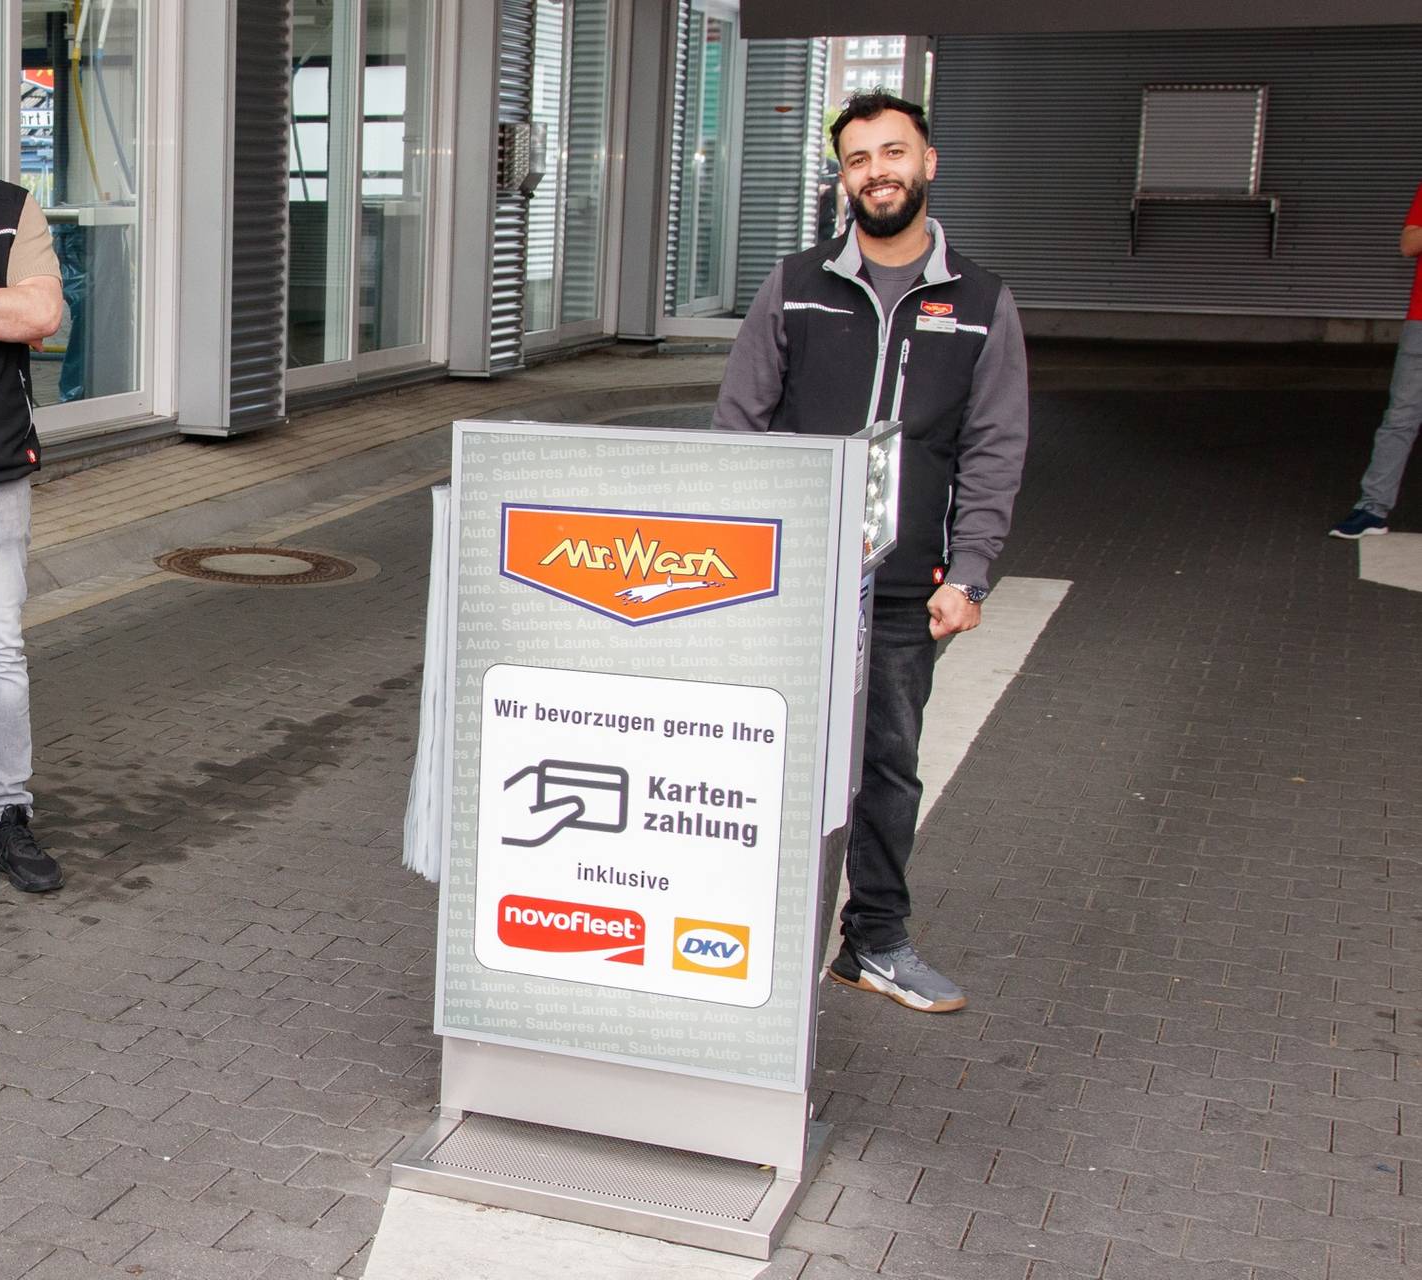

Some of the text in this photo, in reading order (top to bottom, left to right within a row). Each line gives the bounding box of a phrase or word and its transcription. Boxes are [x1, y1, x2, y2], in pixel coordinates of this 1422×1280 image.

[502, 449, 536, 465] gute
[540, 447, 592, 460] Laune.
[596, 444, 669, 457] Sauberes
[492, 468, 563, 481] Sauberes
[568, 465, 603, 478] Auto
[620, 463, 657, 478] gute
[660, 460, 714, 474] Laune.
[718, 457, 795, 472] Sauberes
[505, 488, 538, 503] gute
[543, 485, 594, 498] Laune.
[598, 482, 672, 496] Sauberes
[677, 480, 714, 493] Auto
[732, 477, 769, 494] gute
[462, 526, 496, 538] Auto
[460, 564, 492, 576] Auto
[461, 601, 494, 613] Auto
[512, 602, 545, 615] gute
[502, 618, 571, 631] Sauberes
[726, 614, 802, 628] Sauberes
[466, 638, 500, 650] Auto
[516, 638, 550, 652] gute
[554, 636, 605, 649] Laune.
[610, 634, 682, 649] Sauberes
[686, 634, 724, 647] Auto
[742, 633, 778, 649] gute
[578, 655, 614, 667] Auto
[671, 654, 723, 667] Laune.
[728, 653, 804, 666] Sauberes
[494, 699, 528, 719] Wir
[535, 703, 655, 733] bevorzugen
[664, 718, 724, 739] gerne
[732, 722, 775, 744] Ihre
[648, 776, 758, 809] Karten-
[643, 811, 758, 848] zahlung
[577, 862, 670, 891] inklusive
[504, 905, 740, 959] novofleet DKV
[471, 979, 520, 994] Laune.
[524, 982, 593, 998] Sauberes
[485, 997, 519, 1010] Auto
[536, 1002, 567, 1015] gute
[573, 1003, 621, 1018] Laune.
[626, 1006, 698, 1022] Sauberes
[703, 1010, 739, 1024] Auto
[474, 1015, 521, 1028] Laune.
[525, 1017, 594, 1033] Sauberes
[598, 1022, 634, 1036] Auto
[650, 1026, 684, 1040] gute
[689, 1027, 741, 1042] Laune.
[629, 1042, 700, 1058] Sauberes
[705, 1047, 741, 1060] Auto
